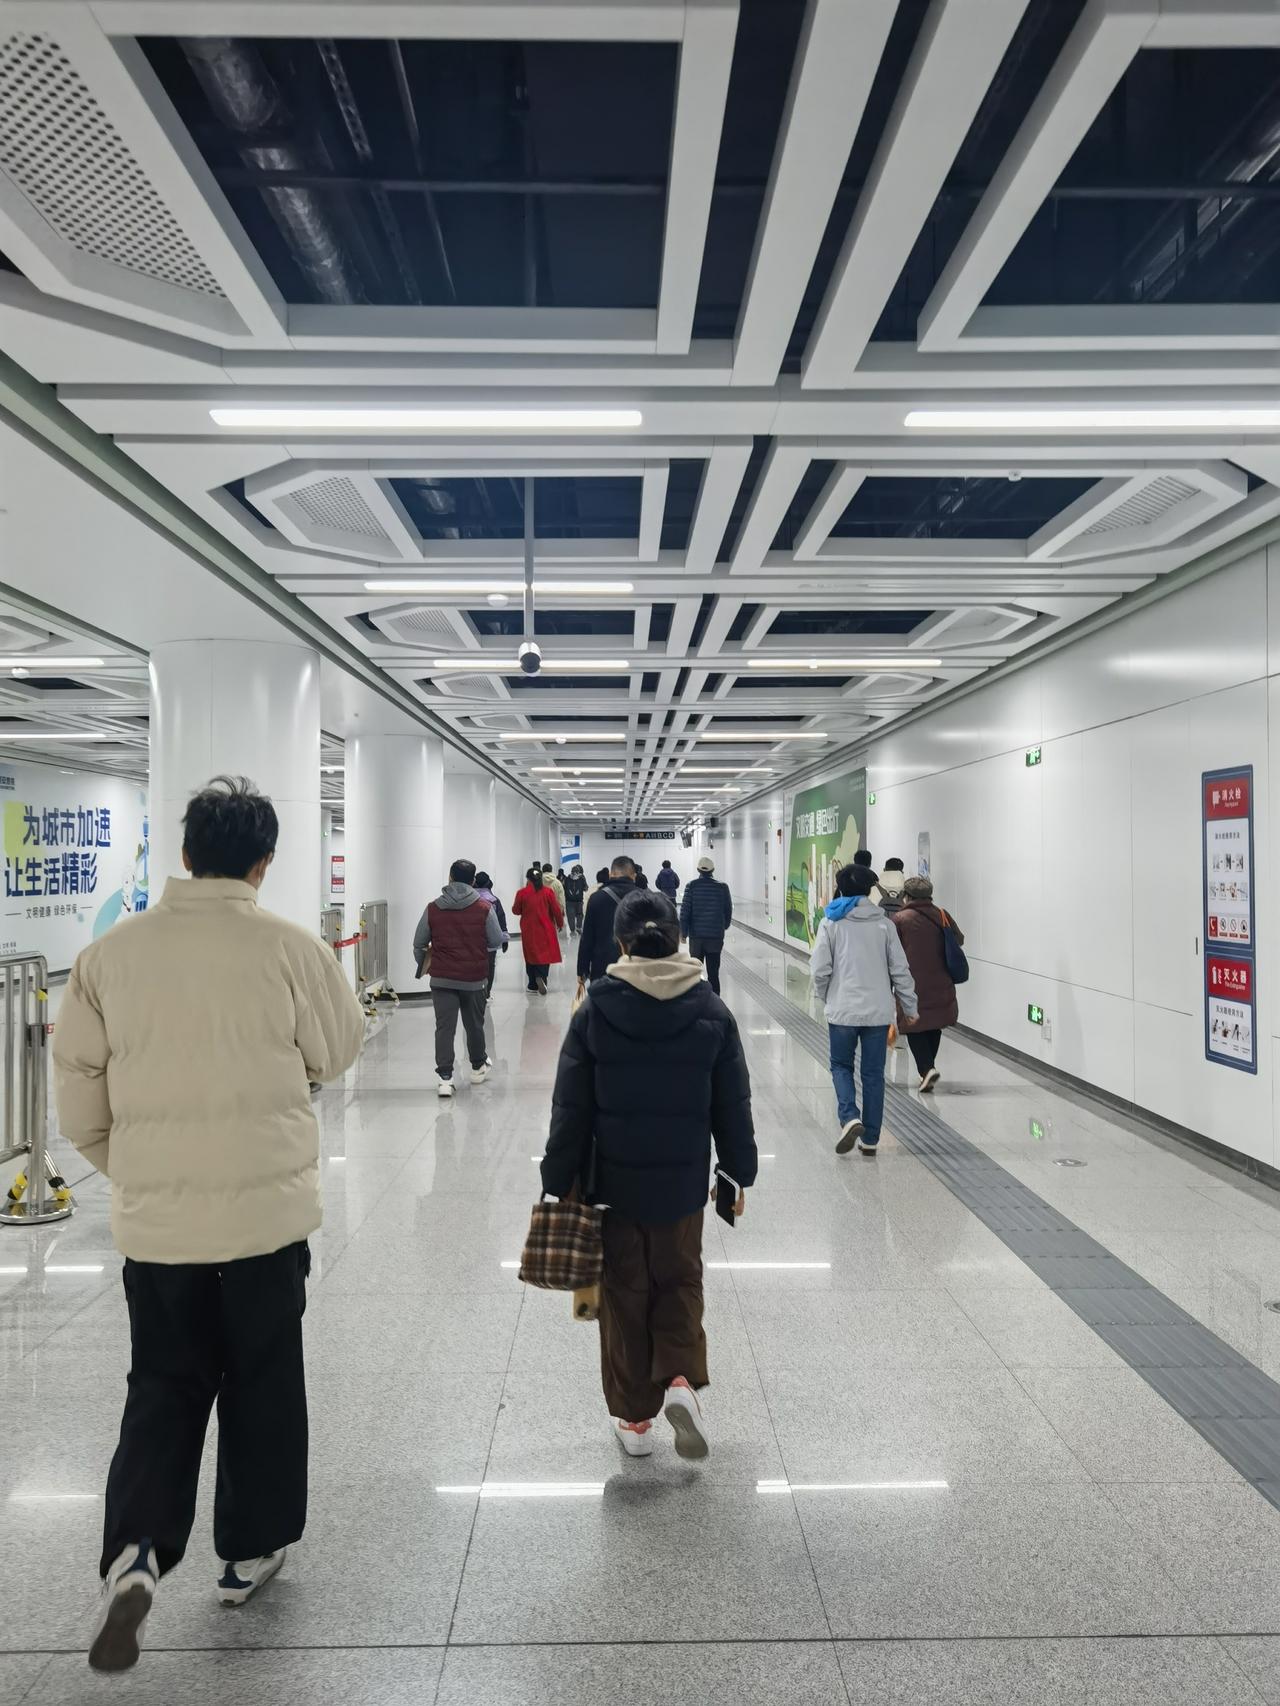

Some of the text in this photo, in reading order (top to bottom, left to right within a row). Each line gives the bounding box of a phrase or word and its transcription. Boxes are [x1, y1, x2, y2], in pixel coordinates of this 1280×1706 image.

[23, 805, 111, 848] 为城市加速
[5, 852, 98, 897] 让生活精彩
[1223, 968, 1247, 984] 灭火器
